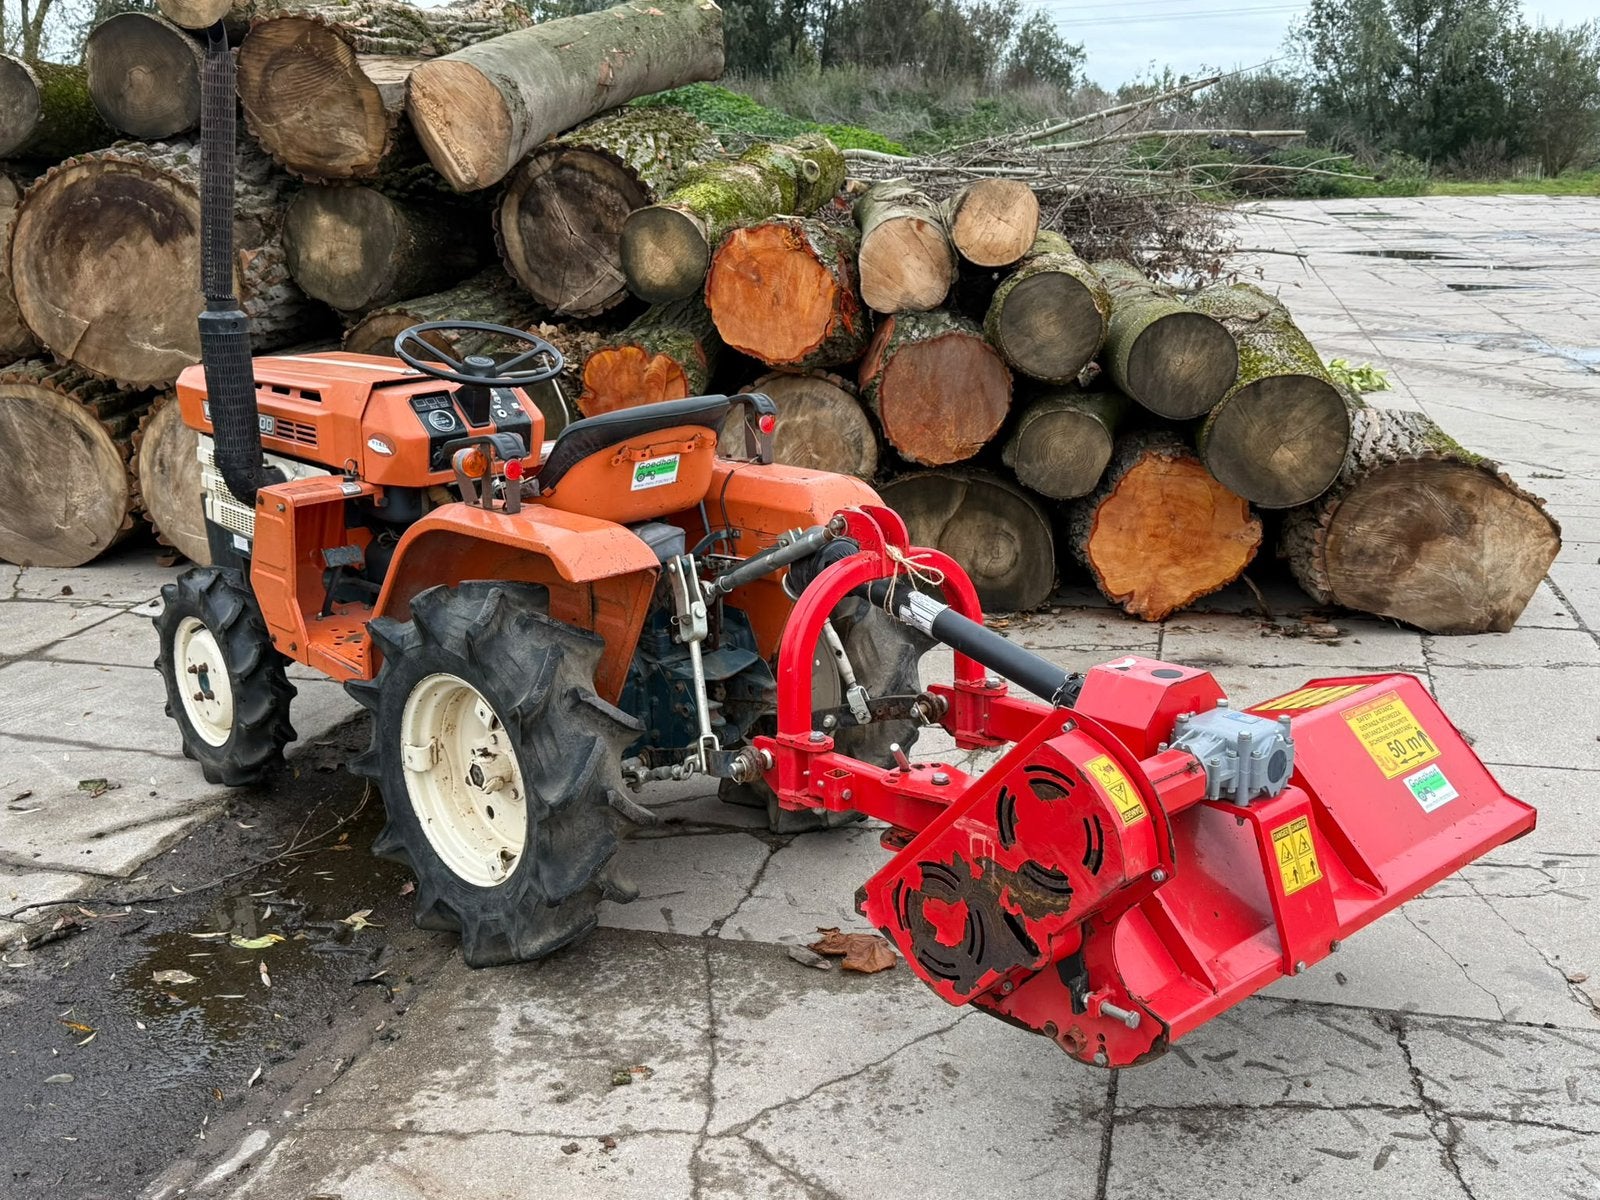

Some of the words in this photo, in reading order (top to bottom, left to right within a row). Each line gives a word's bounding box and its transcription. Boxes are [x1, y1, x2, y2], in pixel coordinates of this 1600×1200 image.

[1356, 714, 1372, 723] SAFETY
[1374, 704, 1394, 716] DISTANCE
[1386, 739, 1407, 759] 50
[1406, 736, 1423, 751] m
